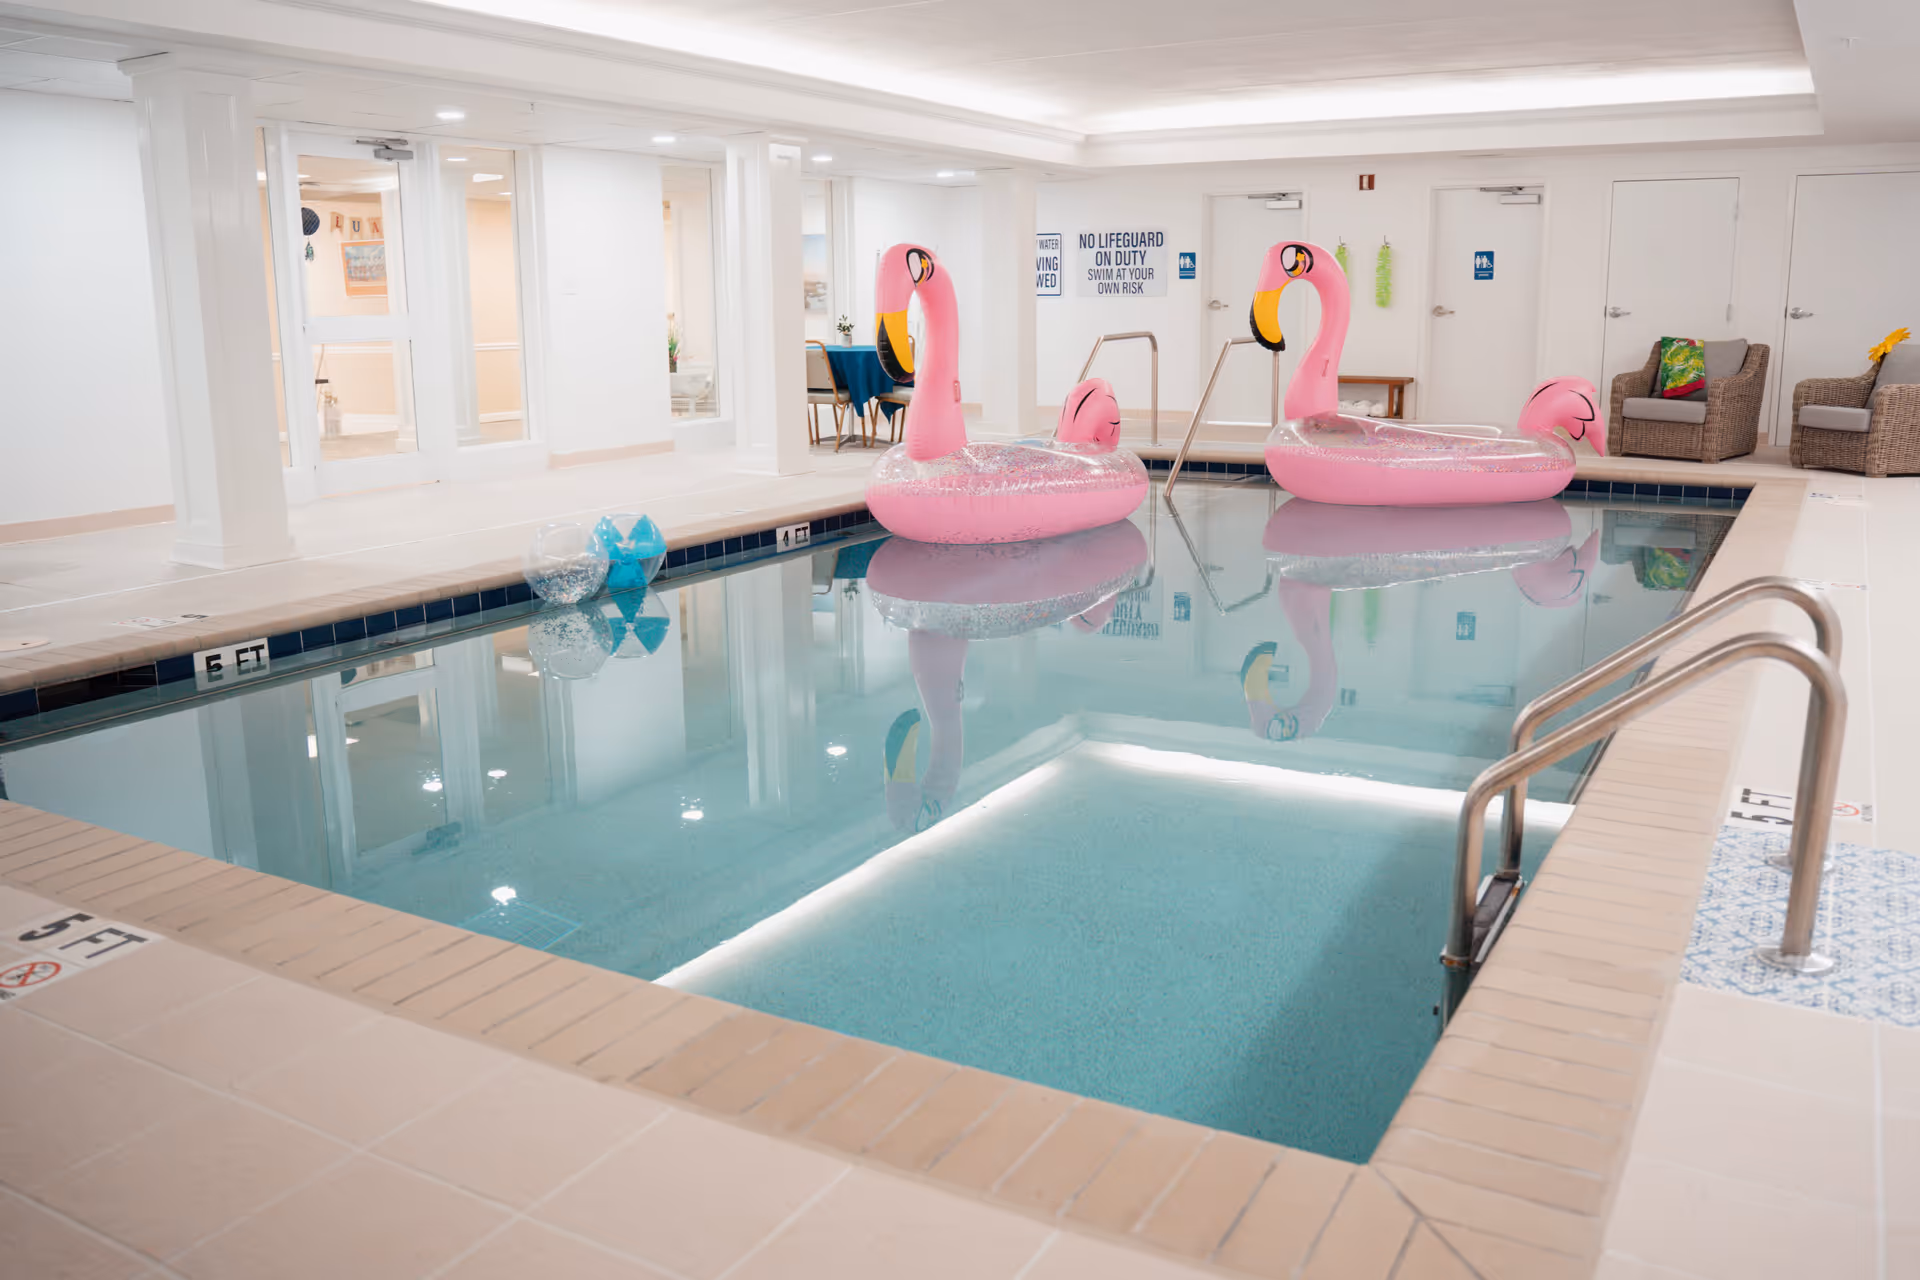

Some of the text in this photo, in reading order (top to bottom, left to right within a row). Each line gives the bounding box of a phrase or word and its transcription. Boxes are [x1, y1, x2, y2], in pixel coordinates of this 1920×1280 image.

[1039, 239, 1059, 250] WATER
[1079, 231, 1164, 249] NO LIFEGUARD
[1095, 250, 1147, 266] ON DUTY
[1087, 267, 1154, 281] SWIM AT YOUR
[1097, 282, 1144, 294] OWN RISK
[205, 644, 265, 672] 5 FT
[1740, 788, 1793, 811] FT
[1730, 811, 1794, 826] 5
[18, 912, 95, 942] 5
[58, 927, 149, 960] FT
